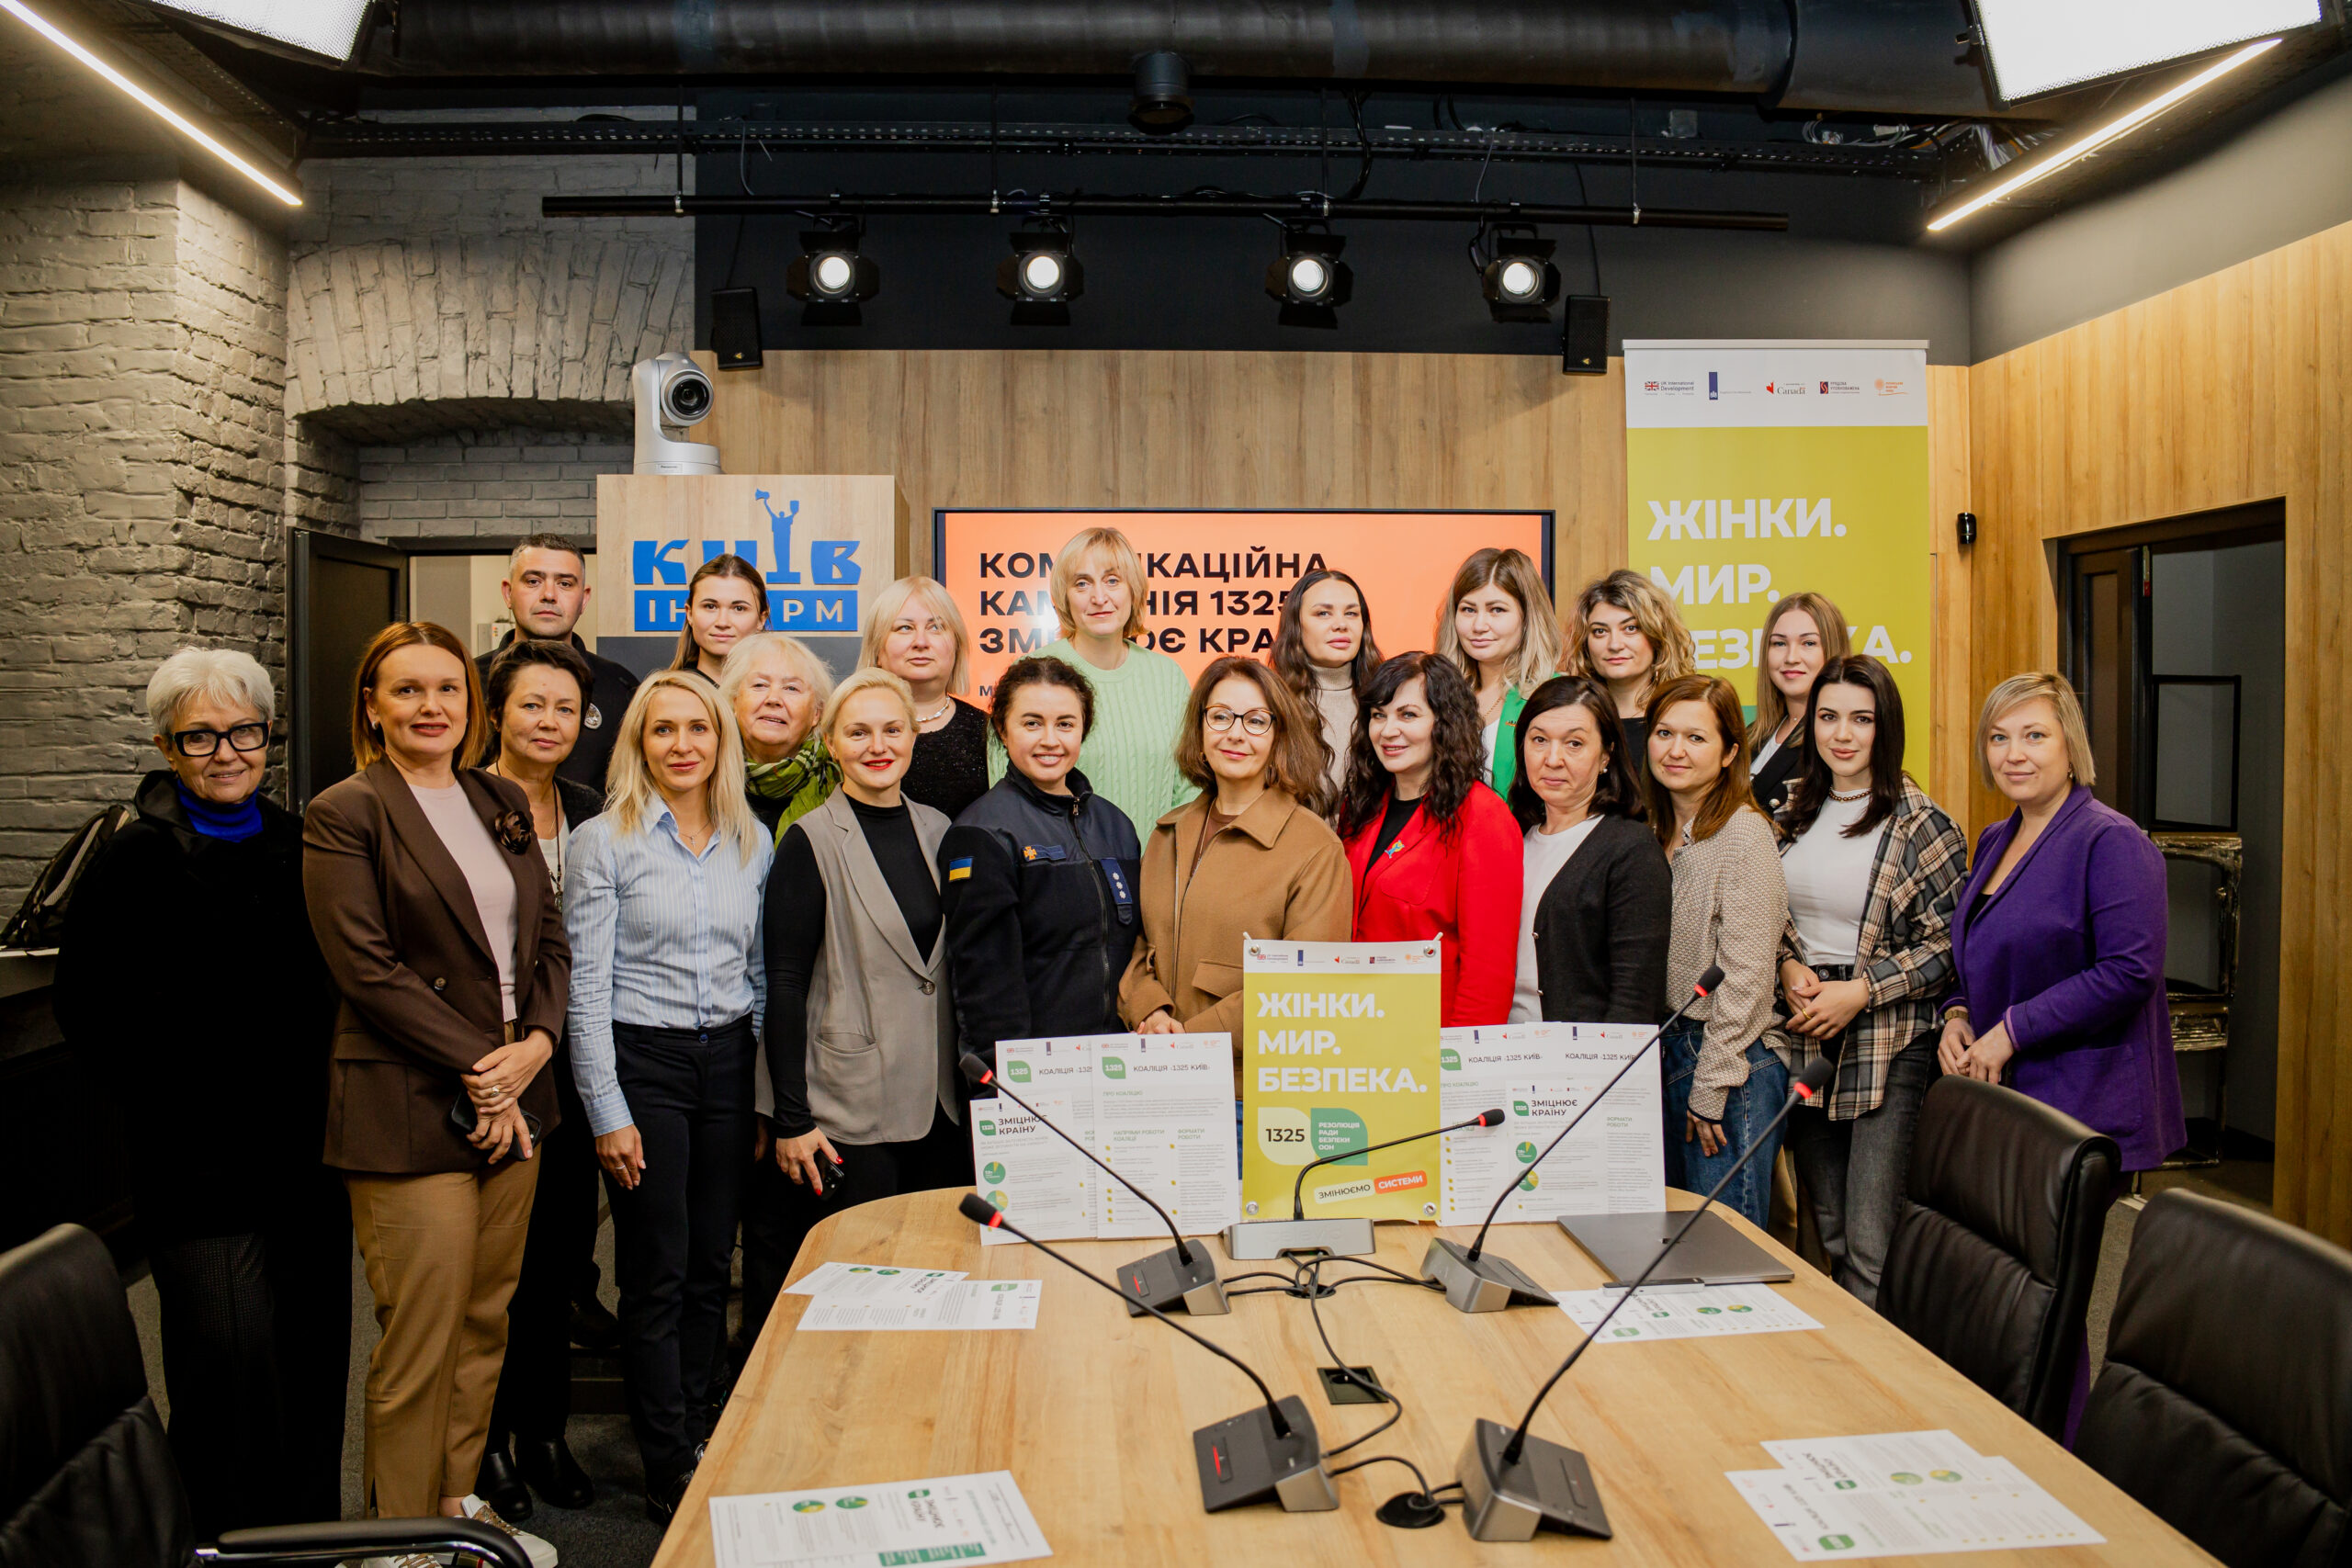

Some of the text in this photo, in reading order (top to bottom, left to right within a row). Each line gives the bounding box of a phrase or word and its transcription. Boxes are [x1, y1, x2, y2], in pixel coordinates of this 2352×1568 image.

[1777, 386, 1806, 395] Canada
[1647, 498, 1847, 540] ЖІНКИ.
[979, 546, 1328, 582] КОКАЦІЙНА
[1650, 564, 1780, 604] МИР.
[649, 598, 843, 623] ІНРМ
[980, 591, 1197, 615] КАІЯ
[1199, 627, 1275, 653] КРА
[1693, 626, 1912, 670] ЕЗА.
[1257, 992, 1385, 1019] ЖІНКИ.
[1258, 1030, 1341, 1055] МИР.
[1133, 1065, 1168, 1073] КОАЛІЦІЯ
[1468, 1055, 1502, 1064] КОАЛІЦІЯ
[1565, 1053, 1599, 1061] КОАЛІЦІЯ
[1038, 1067, 1074, 1076] КОАЛІЦІЯ
[1258, 1067, 1428, 1093] БЕЗПЕКА.
[1531, 1100, 1578, 1109] ЗМІЦНЮЄ
[1532, 1108, 1566, 1116] КРАЇНУ
[998, 1114, 1047, 1126] ЗМІЦНЮ
[999, 1124, 1036, 1135] КРАЇНУ
[1266, 1128, 1306, 1143] 1325
[1318, 1174, 1424, 1200] ЗМІНЮЄМО СИСТЕМИ
